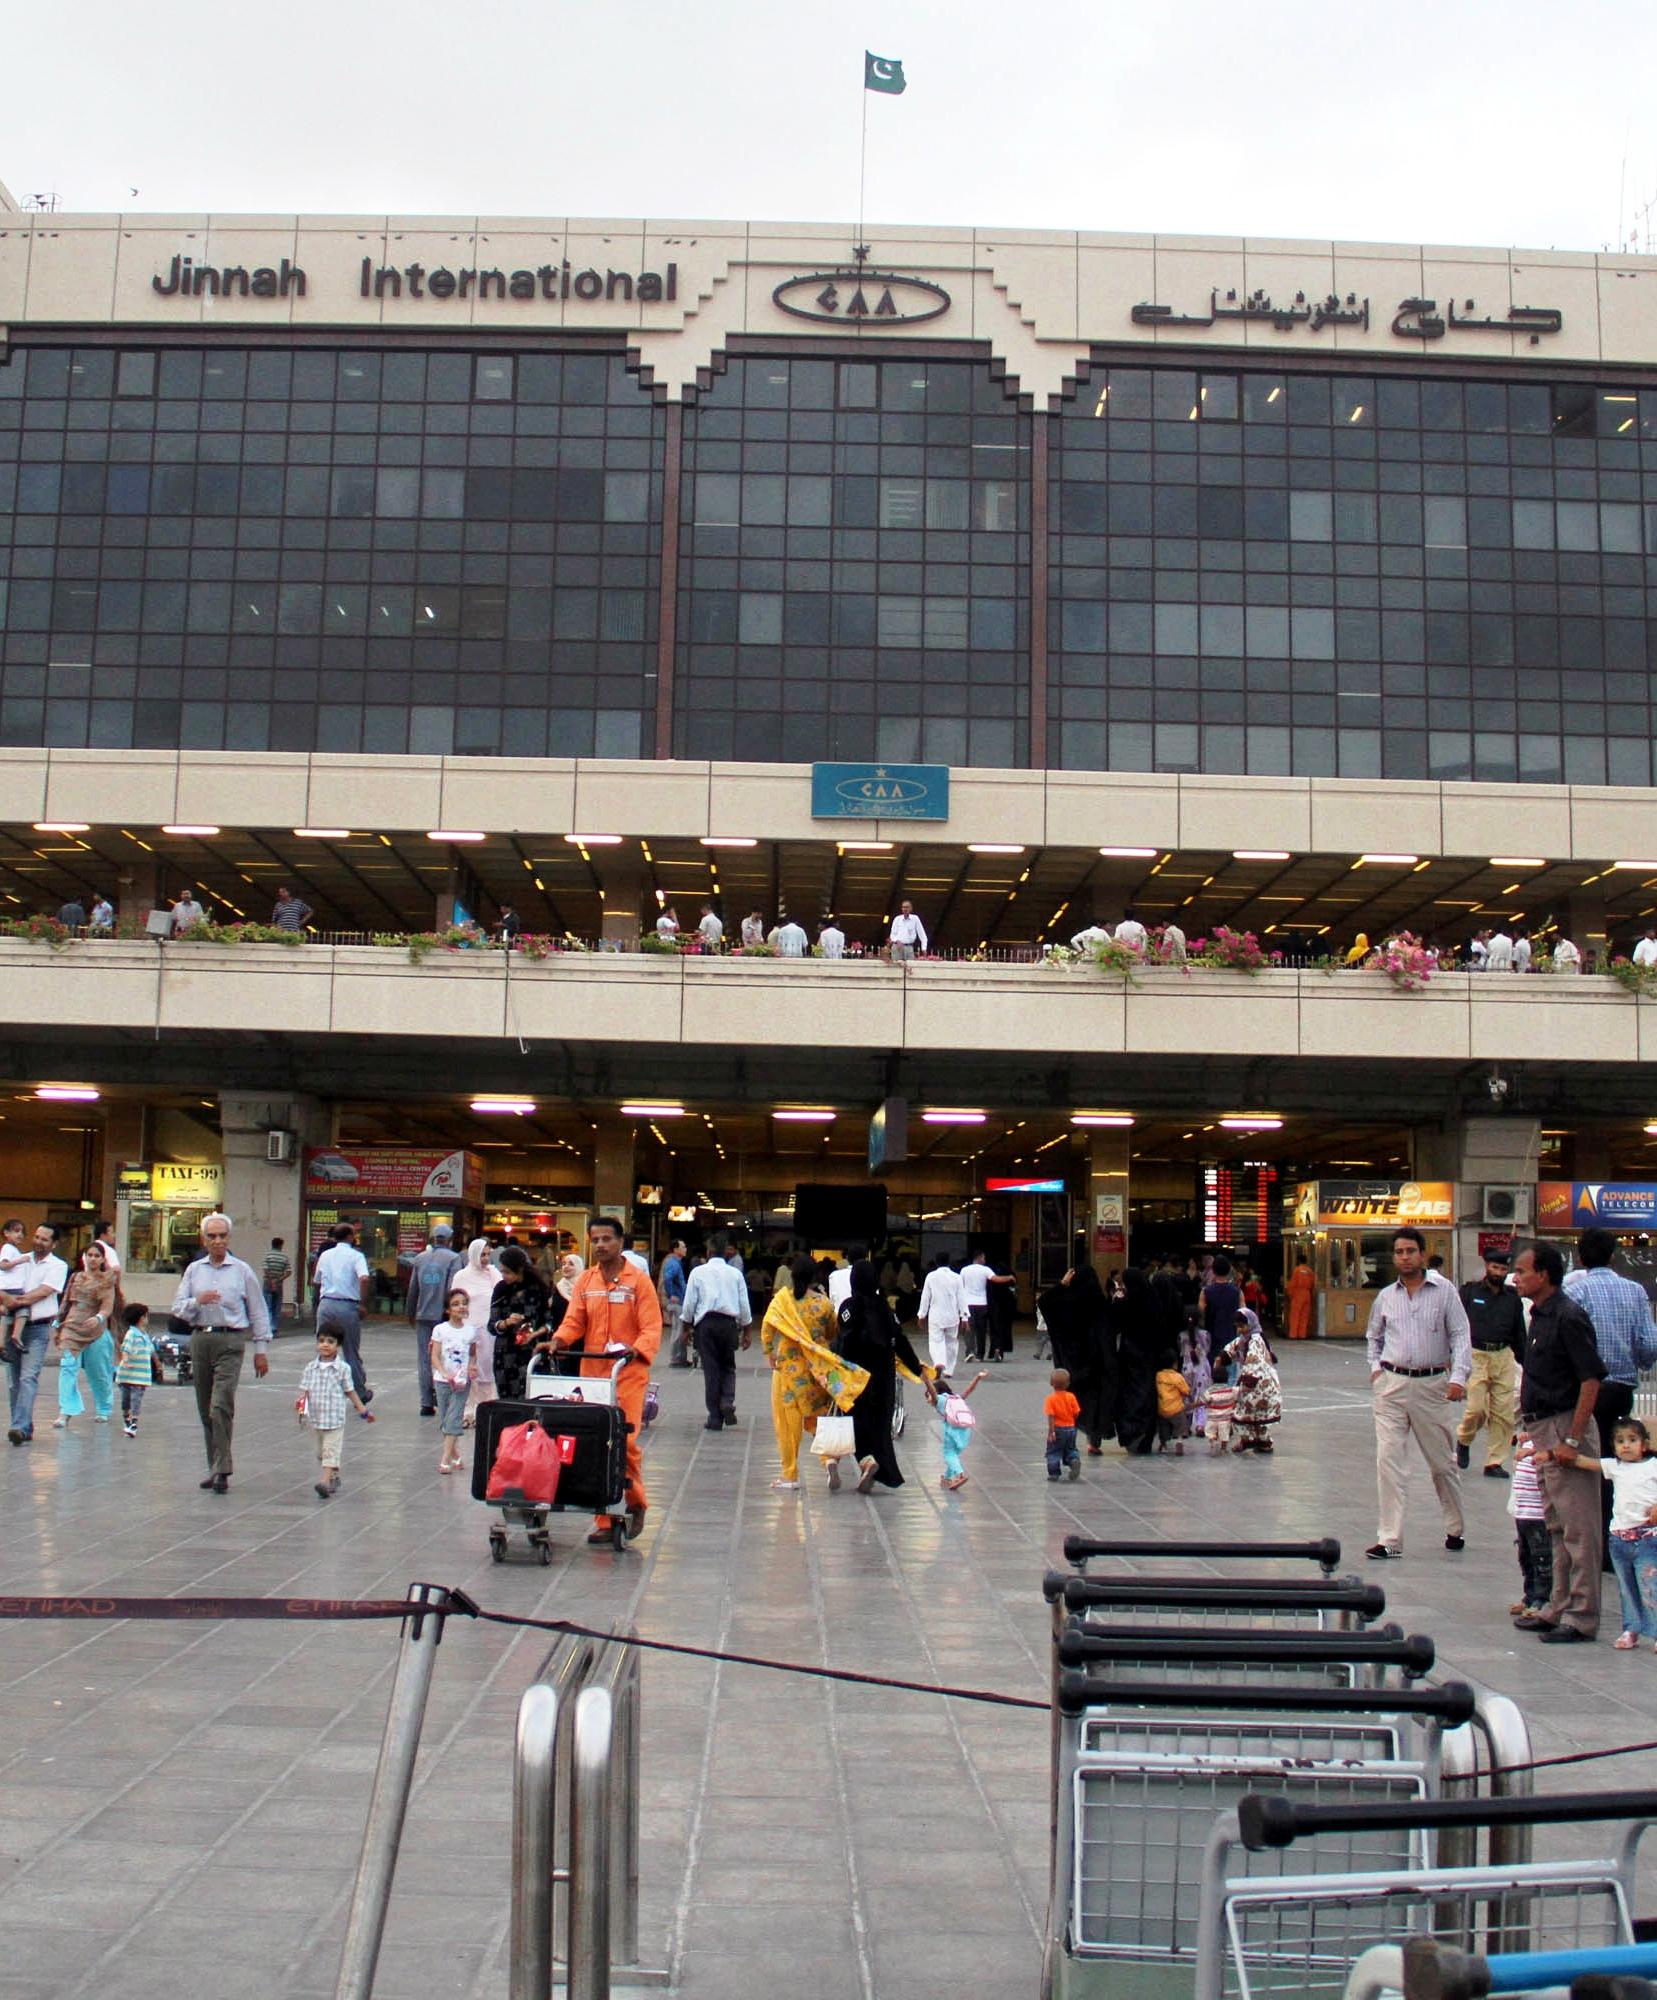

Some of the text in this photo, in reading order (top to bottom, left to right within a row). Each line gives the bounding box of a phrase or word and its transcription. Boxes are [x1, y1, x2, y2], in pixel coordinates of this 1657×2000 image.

[152, 254, 678, 303] Jinnah International
[815, 284, 898, 315] CAA
[1391, 296, 1562, 346] جناح
[860, 782, 903, 798] CAA
[159, 1166, 218, 1180] TAXI-99
[1602, 1191, 1655, 1201] ADVANCE
[1400, 1200, 1452, 1216] CAB
[0, 1598, 117, 1615] ETIHAD
